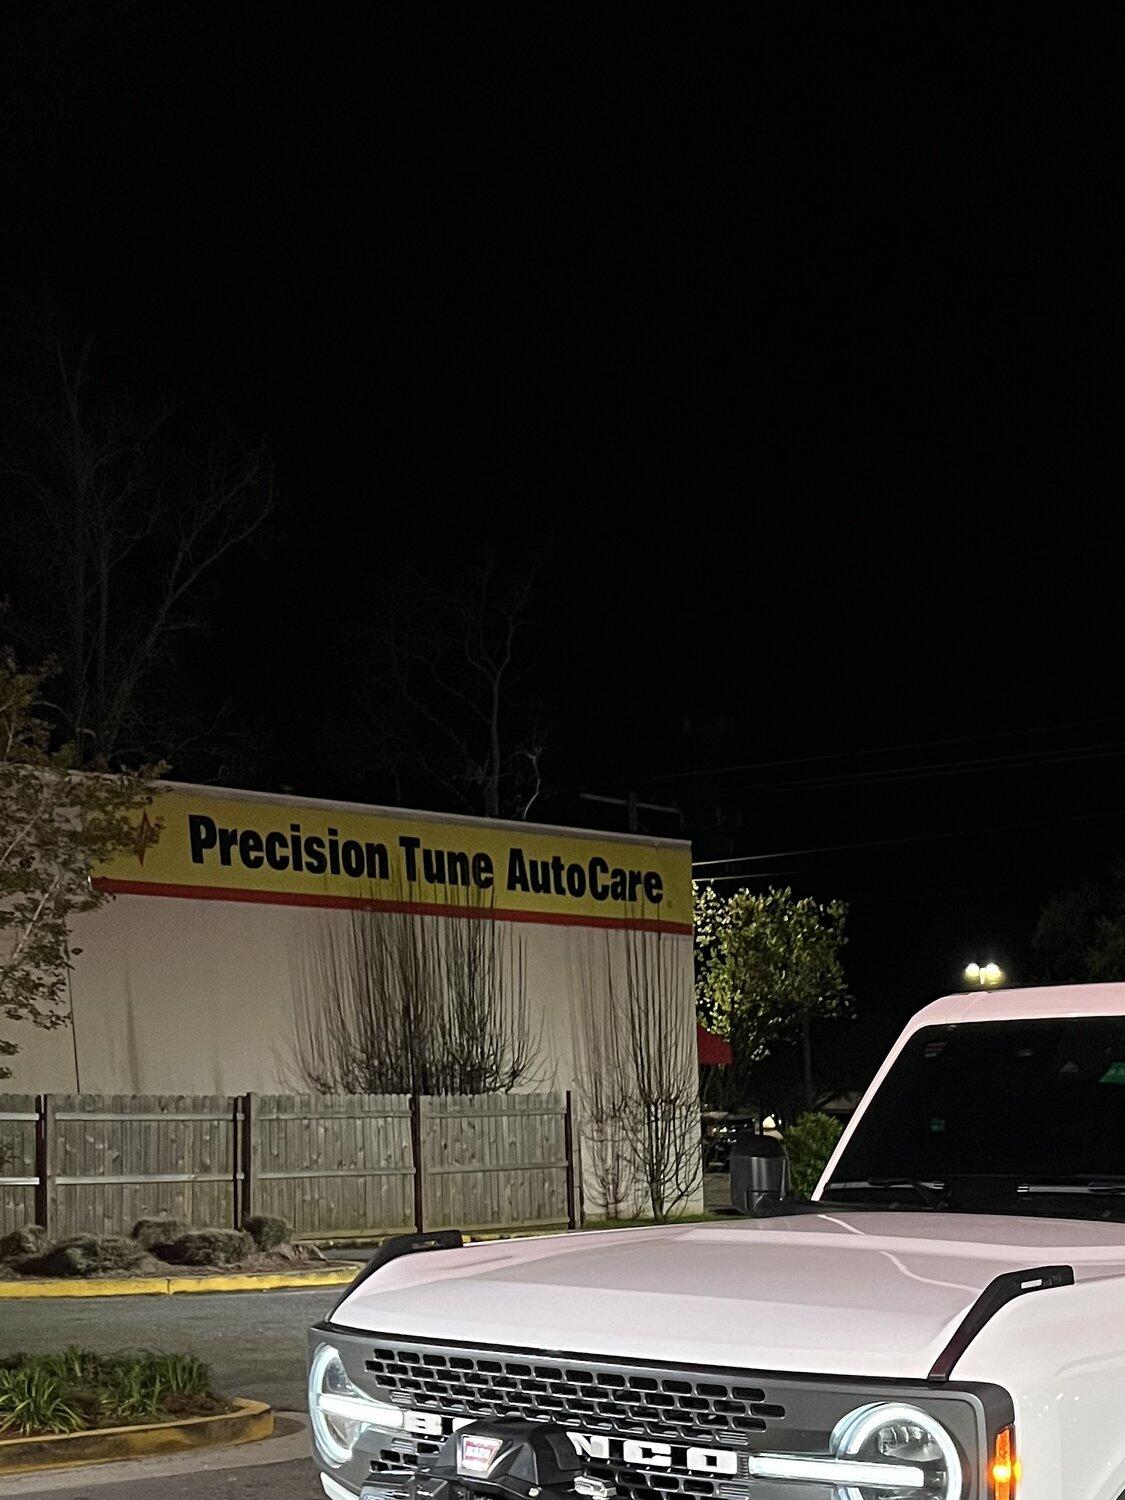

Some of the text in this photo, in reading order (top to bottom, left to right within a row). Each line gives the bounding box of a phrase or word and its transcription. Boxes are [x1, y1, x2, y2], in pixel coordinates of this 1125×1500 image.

[188, 813, 663, 904] Precision Tune AutoCare
[403, 1409, 738, 1475] BNCO
